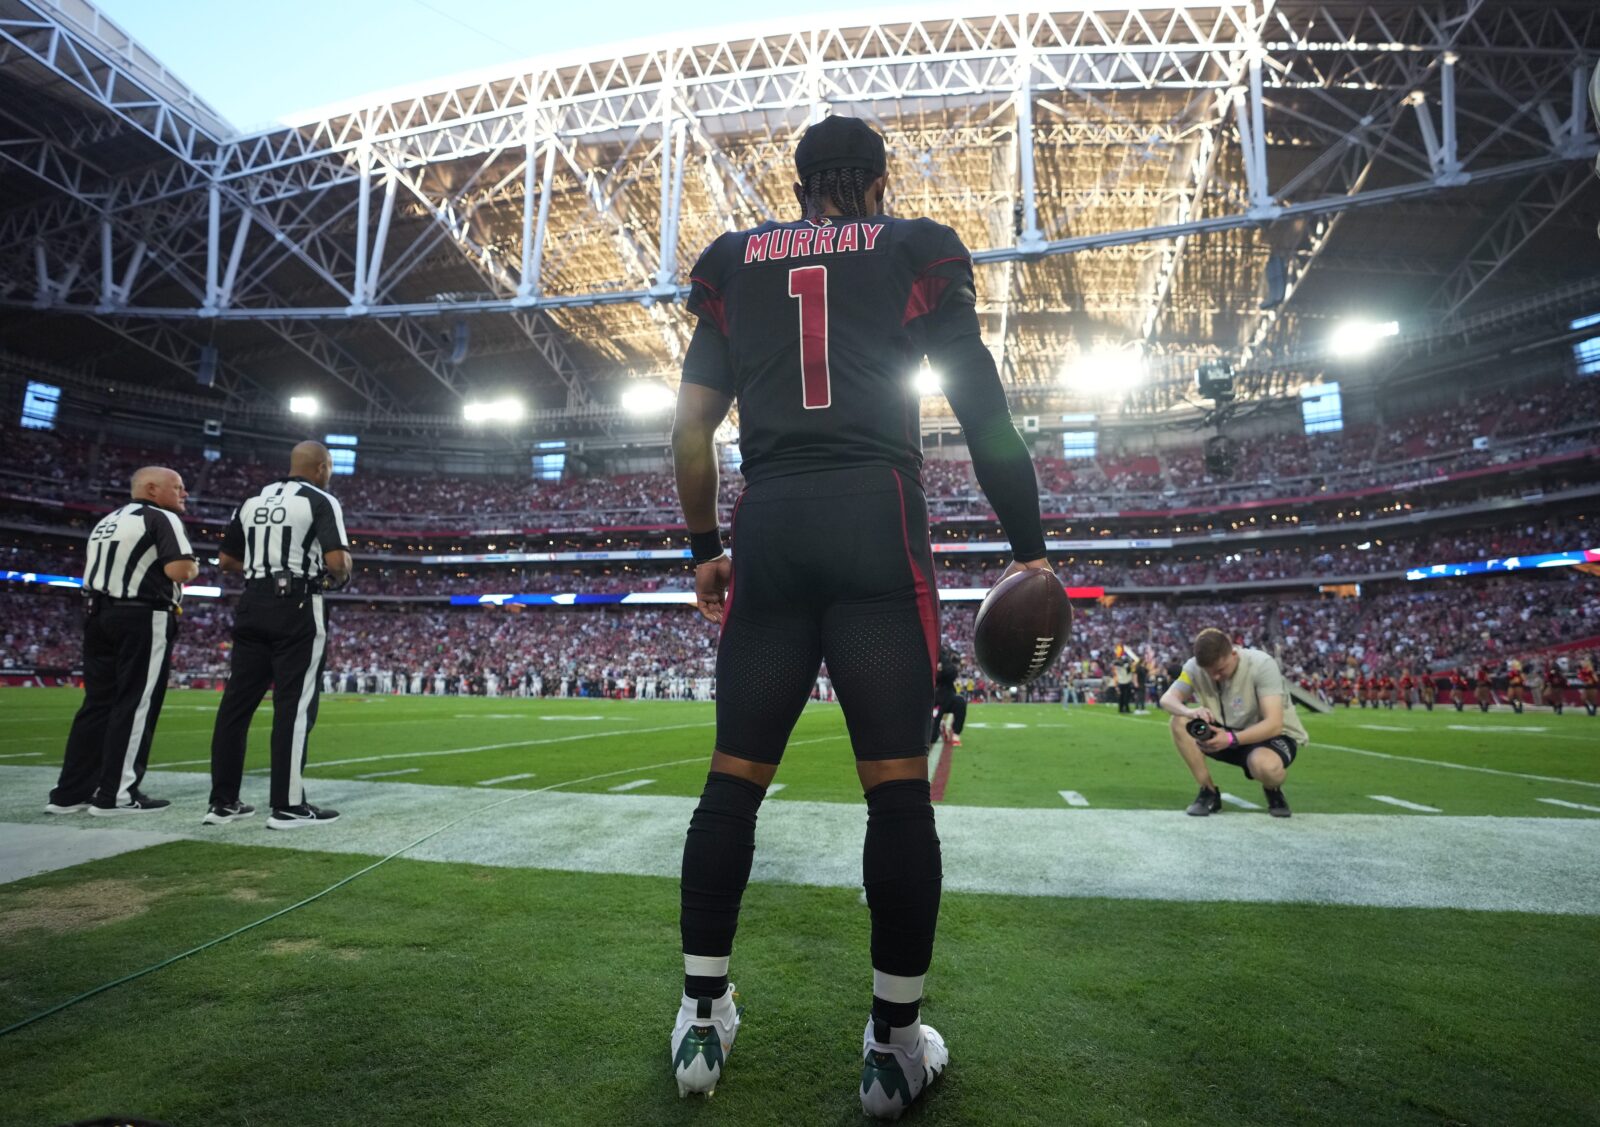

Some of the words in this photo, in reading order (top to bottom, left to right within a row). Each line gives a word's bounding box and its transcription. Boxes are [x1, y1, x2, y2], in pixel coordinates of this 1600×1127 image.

[744, 223, 885, 264] MURRAY
[788, 265, 831, 410] 1
[264, 496, 285, 506] FJ
[253, 506, 287, 525] 80
[90, 523, 118, 541] 59
